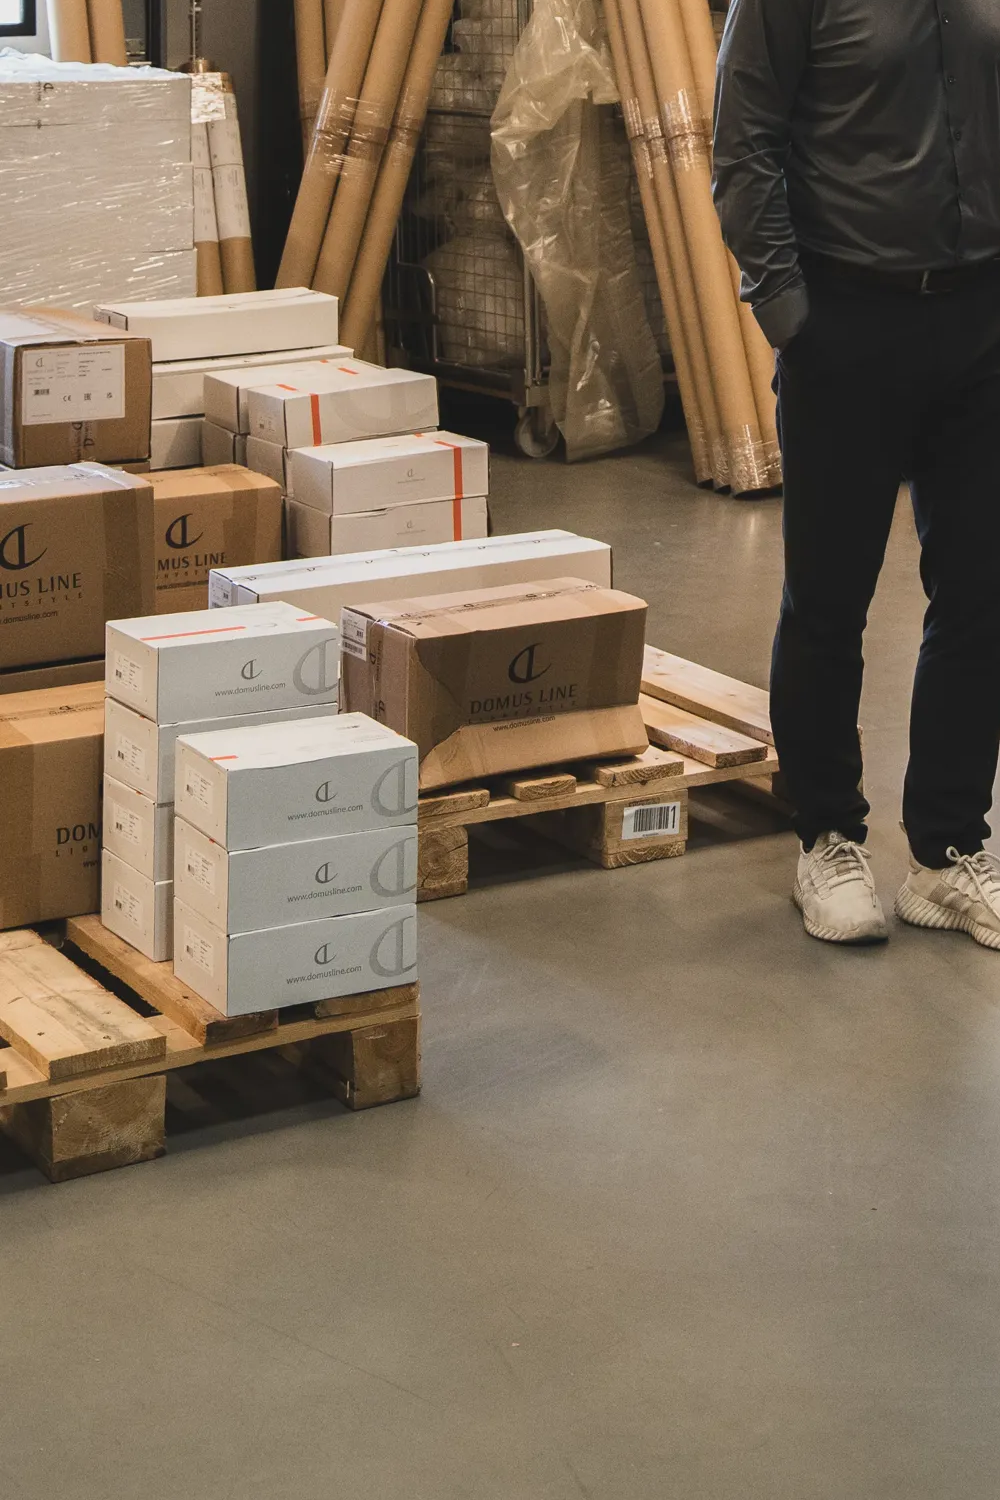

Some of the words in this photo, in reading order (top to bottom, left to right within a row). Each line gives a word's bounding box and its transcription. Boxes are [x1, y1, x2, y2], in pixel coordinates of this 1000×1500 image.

[0, 580, 31, 600] US
[37, 572, 82, 594] LINE
[214, 681, 286, 698] www.domusline.com
[469, 691, 533, 715] DOMUS
[539, 683, 578, 703] LINE
[492, 715, 556, 732] www.domusline.com
[287, 803, 363, 821] www.domusline.com
[670, 805, 677, 829] 1
[287, 884, 363, 903] www.domusline.com
[286, 964, 362, 985] www.domusline.com
